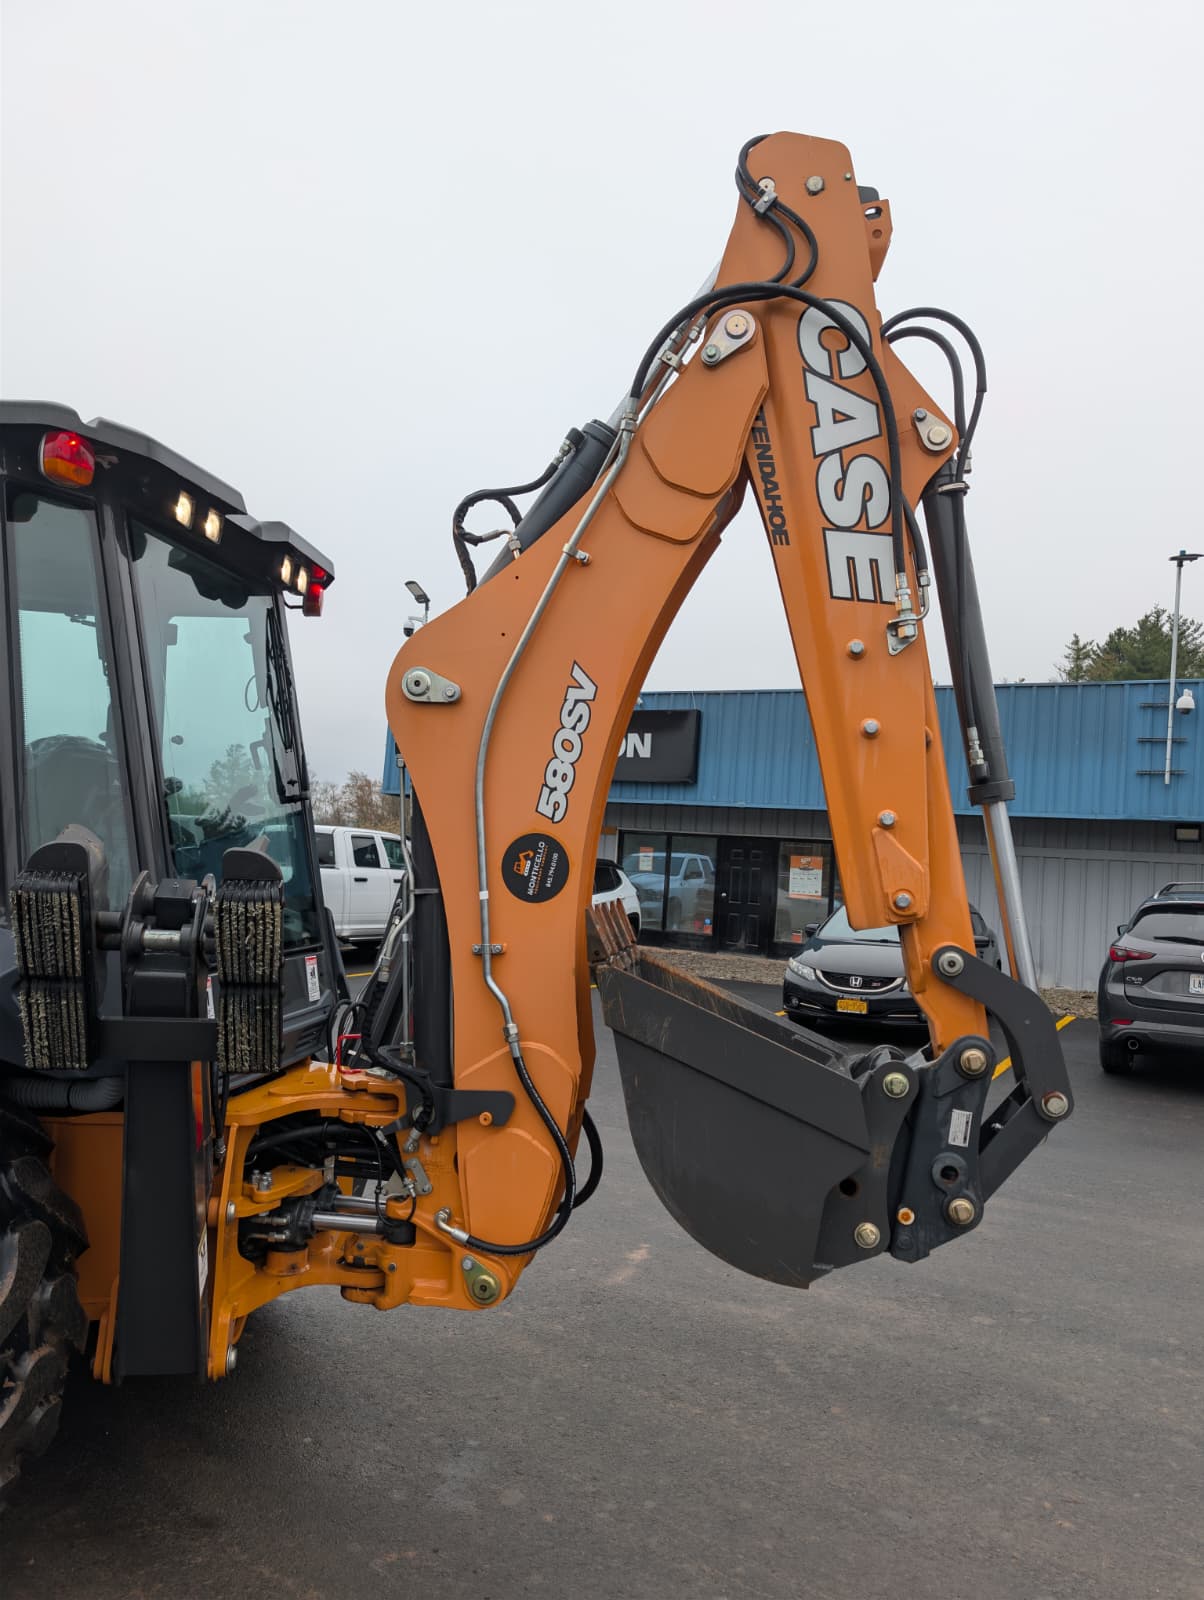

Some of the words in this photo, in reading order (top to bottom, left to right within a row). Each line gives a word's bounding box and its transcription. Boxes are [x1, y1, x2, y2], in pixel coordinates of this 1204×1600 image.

[797, 299, 896, 604] CASE
[535, 661, 598, 823] 580SV
[527, 841, 546, 896] MONTICELLO
